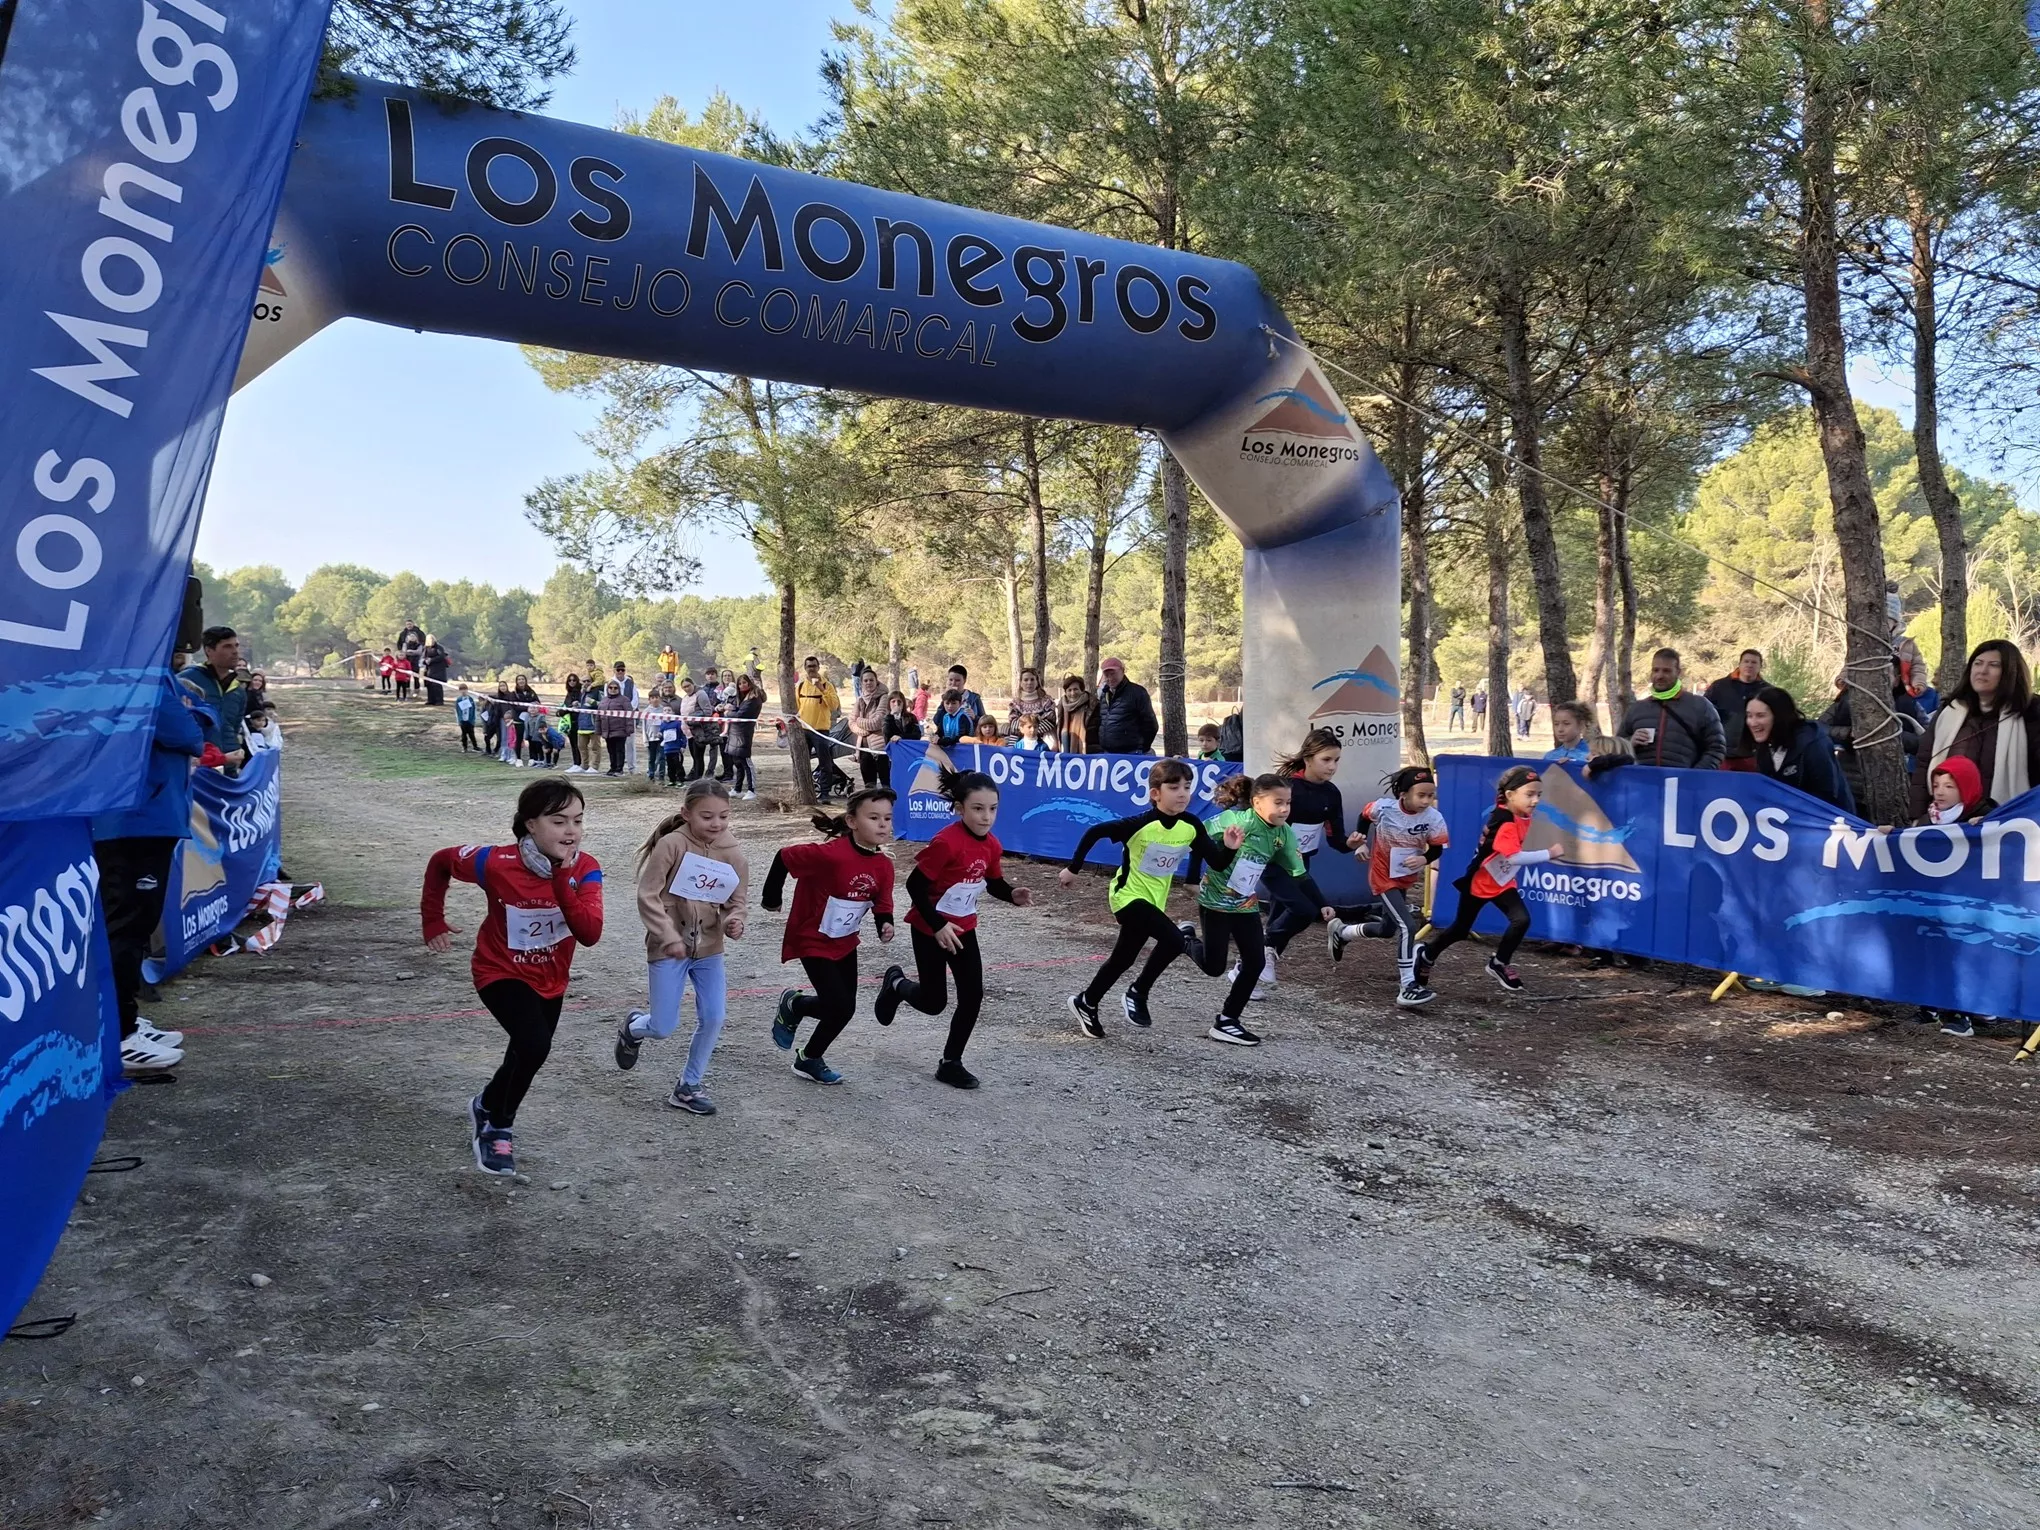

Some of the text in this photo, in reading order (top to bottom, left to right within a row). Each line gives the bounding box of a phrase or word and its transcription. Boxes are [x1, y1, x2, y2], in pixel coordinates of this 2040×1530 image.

[384, 97, 1218, 343] Los Monegros
[387, 223, 997, 367] CONSEJO COMARCAL
[1240, 452, 1328, 468] CONSEJO COMARCAL
[1241, 437, 1360, 463] Los Monegros
[0, 449, 116, 650] Los
[1663, 777, 1790, 861] Los
[1156, 856, 1175, 869] 30
[694, 874, 719, 891] 34
[1523, 865, 1642, 902] Monegros
[1528, 889, 1587, 908] COMARCAL
[529, 921, 554, 938] 21
